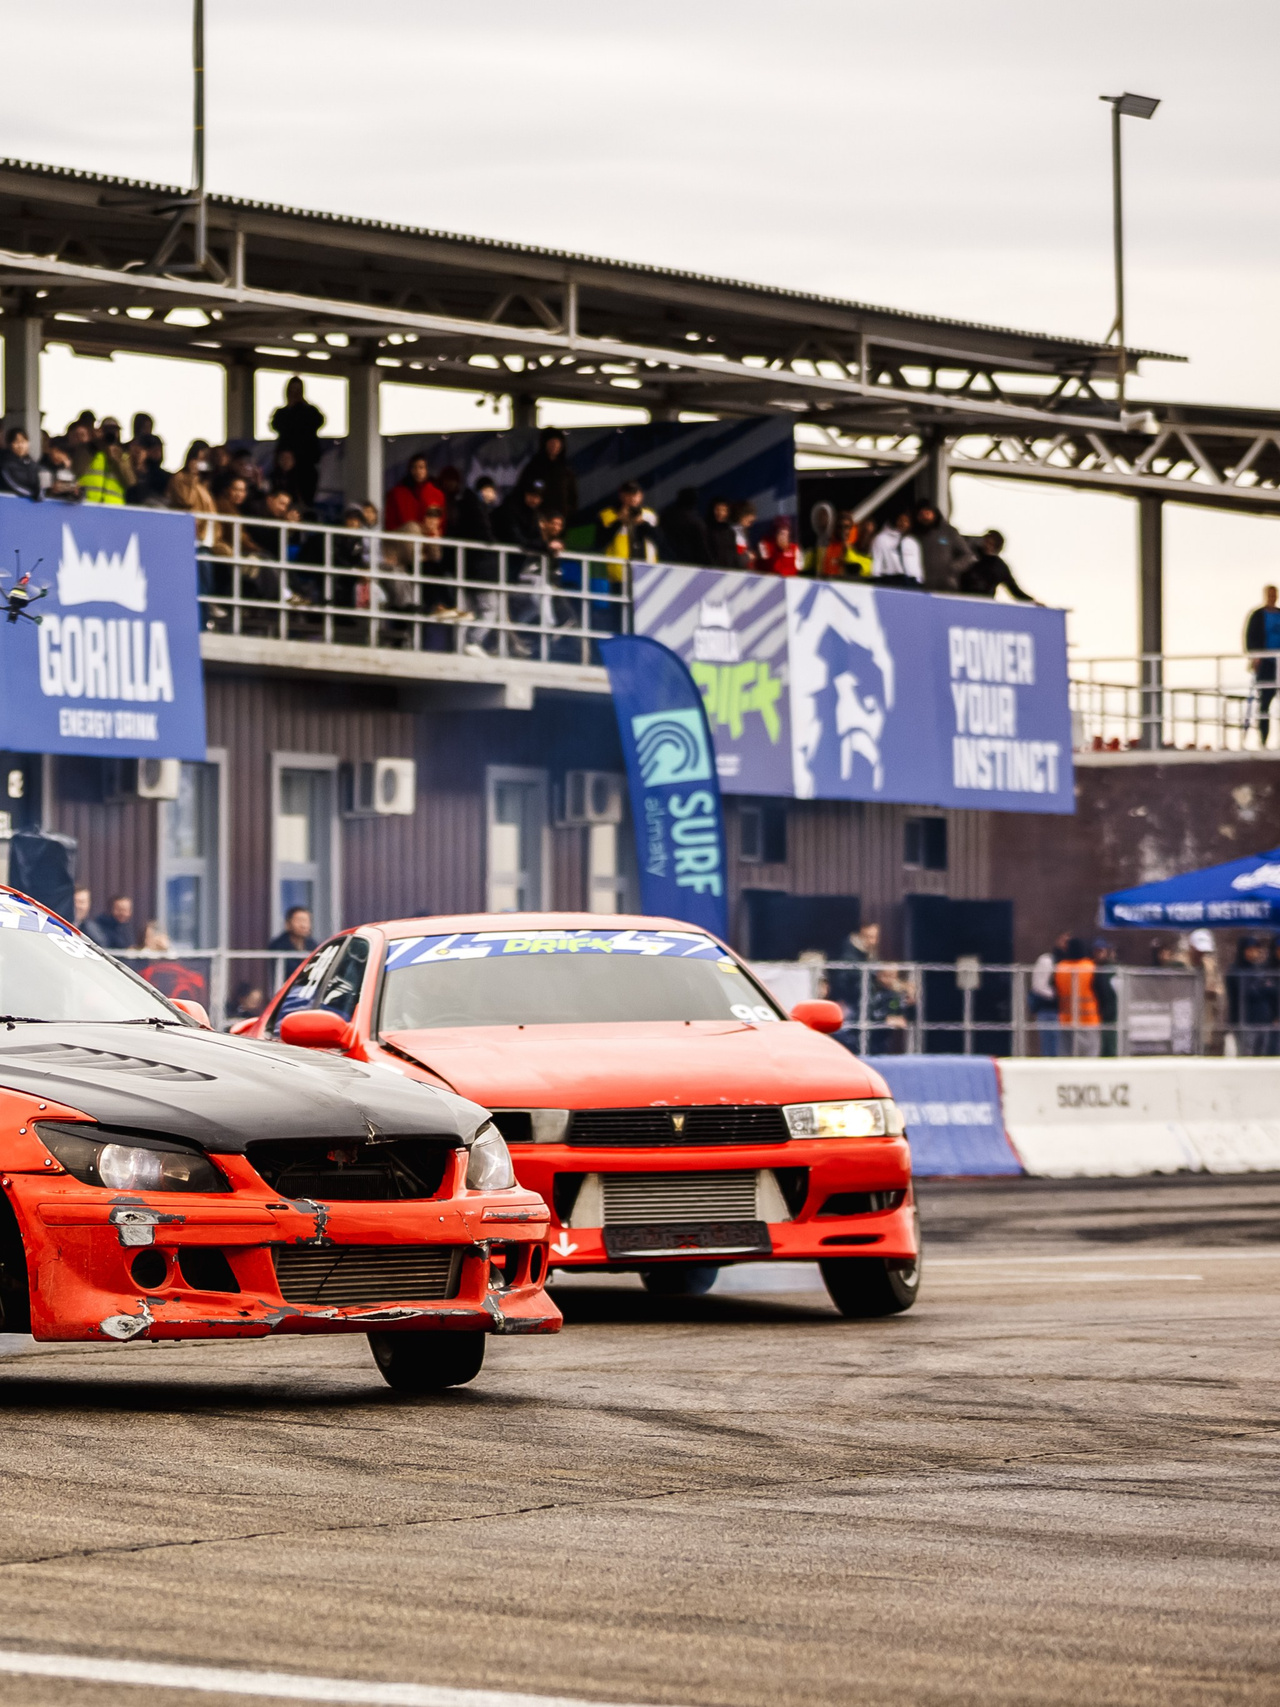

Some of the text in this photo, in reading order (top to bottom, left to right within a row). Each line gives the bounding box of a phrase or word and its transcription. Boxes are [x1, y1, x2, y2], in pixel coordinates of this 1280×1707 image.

[38, 614, 174, 703] GORILLA
[948, 626, 1035, 685] POWER
[59, 707, 159, 741] ENERGY DRINK
[950, 681, 1017, 738] YOUR
[952, 735, 1060, 794] INSTINCT
[667, 789, 723, 897] SURF
